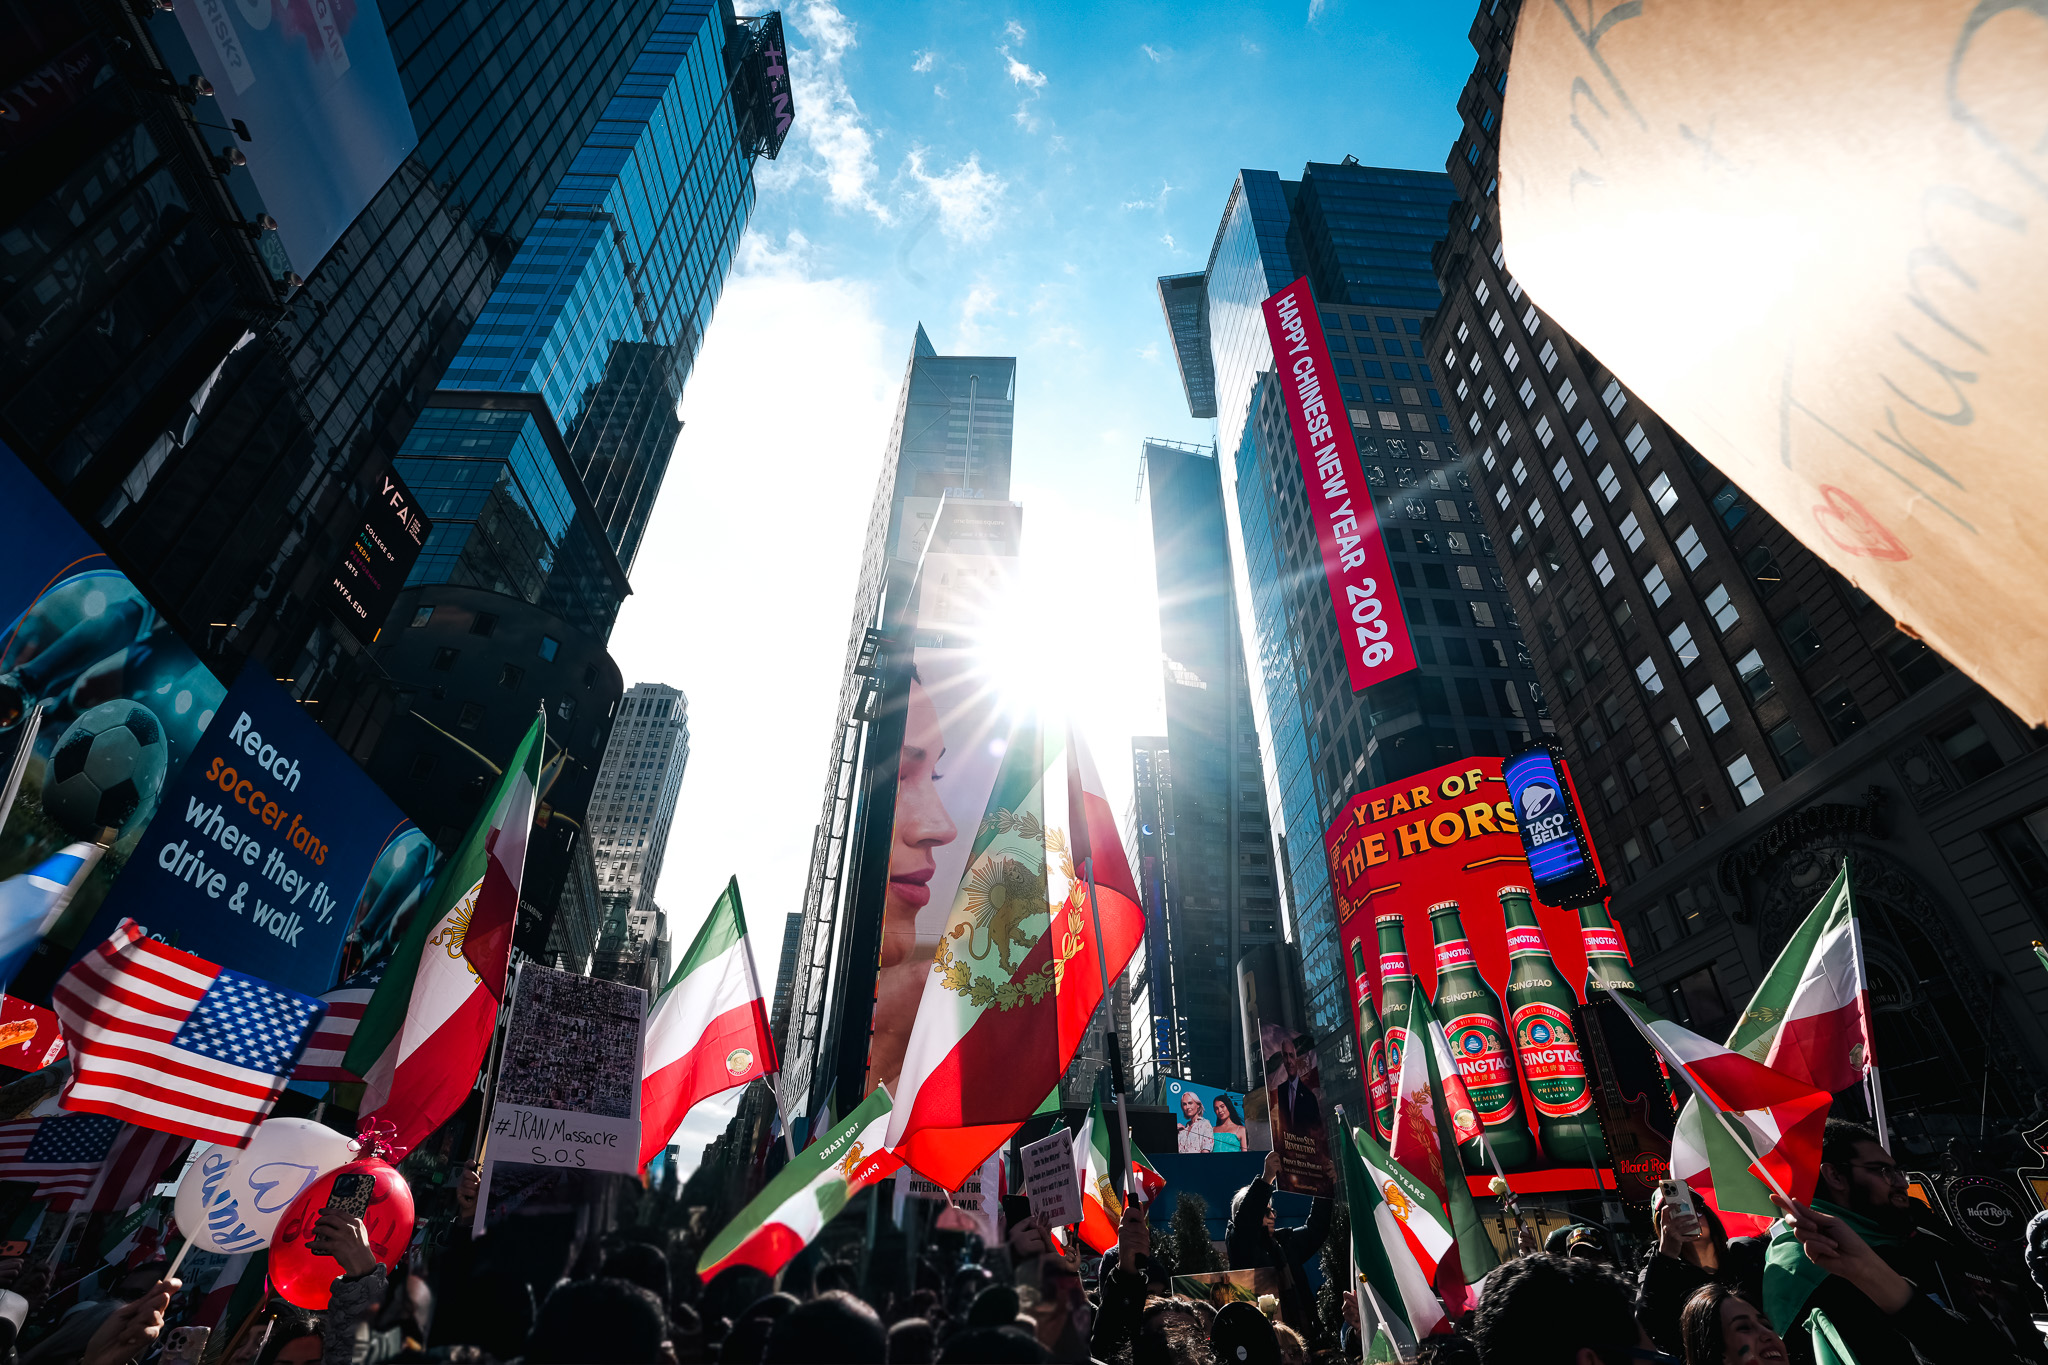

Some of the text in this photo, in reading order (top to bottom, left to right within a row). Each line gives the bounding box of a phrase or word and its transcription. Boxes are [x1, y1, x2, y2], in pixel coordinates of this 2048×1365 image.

[203, 0, 242, 68] RISK?
[1276, 292, 1394, 668] HAPPY CHINESE NEW YEAR 2026
[360, 532, 373, 549] FILM
[365, 523, 395, 563] COLLEGE OF
[354, 541, 371, 564] MEDIA
[344, 560, 359, 578] ARTS
[350, 550, 382, 591] PERFORMING
[333, 578, 368, 619] NYFA.EDU
[228, 710, 302, 793] Reach
[1353, 768, 1483, 826] YEAR OF
[205, 756, 329, 866] soccer fans
[1525, 813, 1565, 836] TACO
[1341, 801, 1520, 888] THE HORS
[1531, 826, 1570, 847] BELL
[184, 795, 337, 925] where they fly,
[158, 839, 227, 899] drive
[228, 881, 249, 915] &
[252, 898, 304, 948] walk
[519, 900, 543, 922] CLIMBING
[1507, 935, 1541, 947] TSINGTAO
[1584, 936, 1618, 946] TSINGTAO
[1437, 947, 1471, 962] TSINGTAO
[1508, 979, 1553, 992] TSINGTAO
[1440, 989, 1486, 1005] TSINGTAO
[1458, 1056, 1512, 1075] INGTAO
[1538, 1086, 1575, 1094] PREMIUM
[1283, 1131, 1297, 1141] LION
[1304, 1136, 1315, 1146] SUN
[1284, 1140, 1316, 1155] REVOLUTION
[531, 1146, 586, 1167] S.O.S
[1620, 1158, 1671, 1175] Hard Roc
[967, 1183, 982, 1193] FOR
[1385, 1160, 1426, 1200] 100 YEARS
[960, 1200, 980, 1211] WAR.
[1967, 1207, 2014, 1219] Hard Rock
